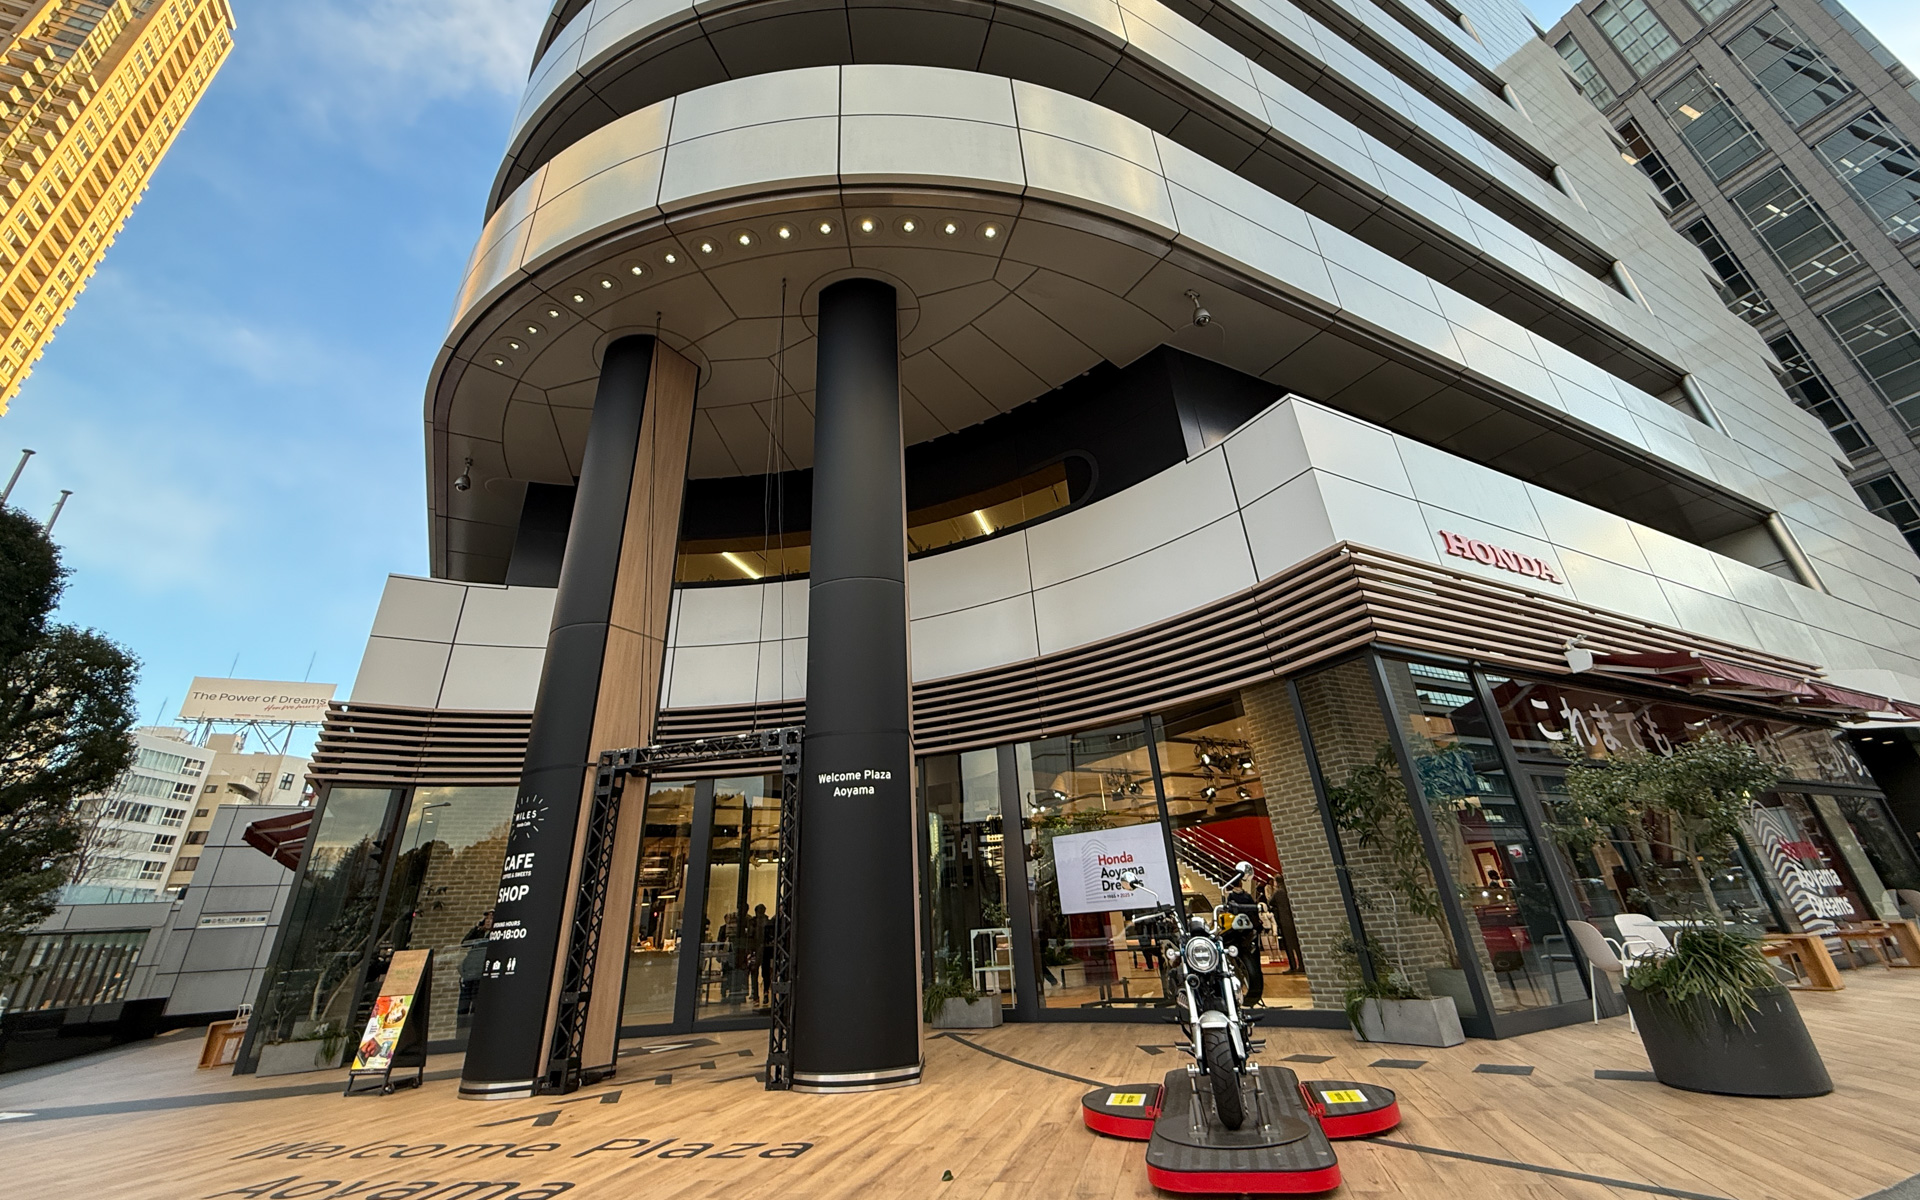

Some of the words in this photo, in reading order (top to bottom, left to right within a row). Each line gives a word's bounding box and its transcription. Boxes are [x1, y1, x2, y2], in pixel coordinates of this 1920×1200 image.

[1438, 530, 1564, 585] HONDA
[192, 691, 217, 701] The
[219, 692, 260, 703] Power
[262, 693, 276, 703] of
[278, 695, 327, 706] Dreams
[818, 771, 861, 784] Welcome
[864, 769, 891, 780] Plaza
[833, 786, 875, 798] Aoyama
[504, 852, 535, 872] CAFE
[1098, 851, 1134, 866] Honda
[1102, 880, 1145, 892] Dres
[1793, 864, 1843, 895] Aoyama
[497, 884, 530, 903] SHOP
[1806, 891, 1856, 918] Dreams
[231, 1138, 563, 1161] Welcome
[571, 1138, 816, 1160] Plaza
[206, 1174, 577, 1200] Aoyama
